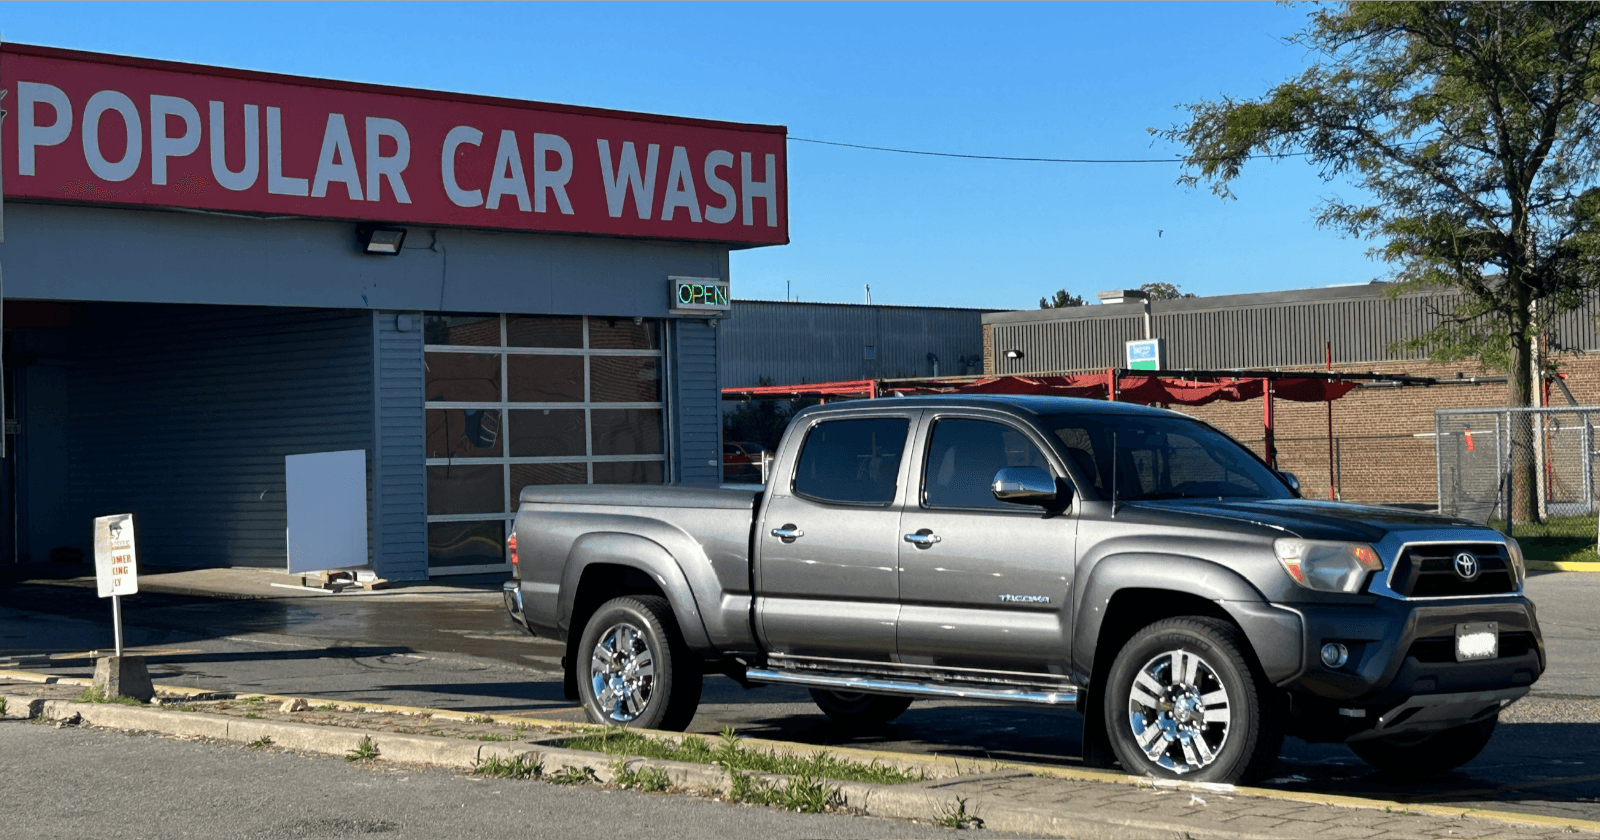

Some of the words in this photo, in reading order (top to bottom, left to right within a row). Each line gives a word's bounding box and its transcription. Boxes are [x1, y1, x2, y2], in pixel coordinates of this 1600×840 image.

[17, 80, 412, 204] POPULAR
[441, 125, 575, 215] CAR
[597, 138, 778, 227] WASH
[679, 284, 727, 305] OPEN
[998, 593, 1051, 603] TACOMA
